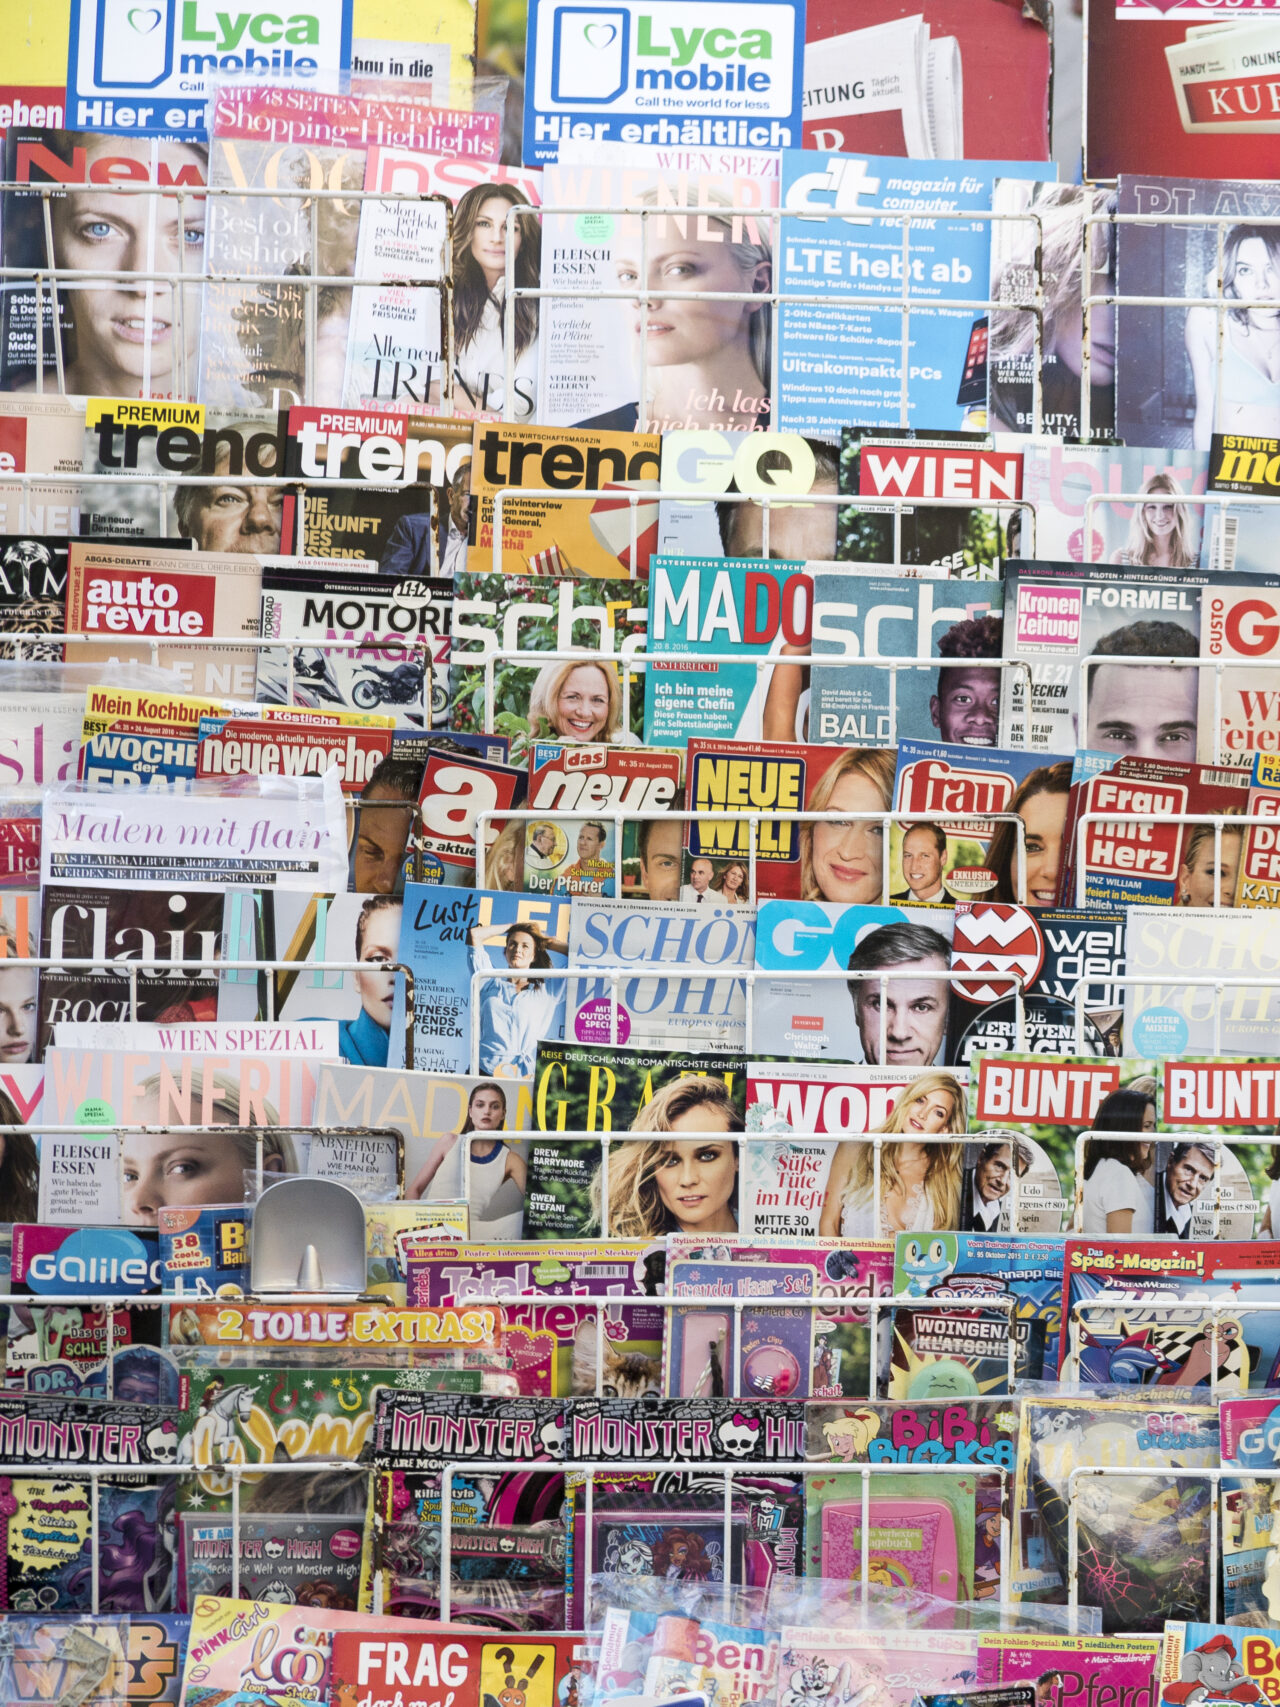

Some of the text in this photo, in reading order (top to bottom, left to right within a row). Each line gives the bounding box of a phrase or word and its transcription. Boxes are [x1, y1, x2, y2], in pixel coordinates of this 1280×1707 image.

[181, 4, 320, 50] Lyca
[637, 16, 772, 65] Lyca
[180, 49, 319, 78] mobile
[1179, 63, 1206, 76] HANDY
[635, 65, 771, 92] mobile
[635, 97, 769, 110] Call the world for less
[216, 101, 494, 156] Shopping-Highlights
[535, 116, 791, 148] Hier erhältlich
[887, 177, 983, 195] magazin für
[786, 249, 972, 284] LTE hebt ab
[117, 406, 200, 424] PREMIUM
[320, 415, 402, 435] PREMIUM
[519, 432, 601, 445] WIRTSCHAFTSMAGAZIN
[676, 431, 816, 505] GQ
[866, 454, 1017, 497] WIEN
[84, 555, 151, 567] ABGAS-DEBATTE
[89, 577, 177, 607] auto
[1019, 588, 1079, 615] Kronen
[1086, 588, 1192, 611] FORMEL
[86, 606, 204, 635] revue
[1018, 613, 1079, 640] Zeitung
[1210, 598, 1223, 654] GUSTO
[654, 684, 733, 697] Ich bin meine
[91, 692, 132, 715] Mein
[654, 696, 735, 711] eigene Chefin
[225, 729, 346, 747] Die moderne, aktuelle Illustrierte
[1263, 755, 1274, 765] 19
[533, 771, 677, 810] neue
[699, 757, 800, 806] NEUE
[1097, 783, 1175, 814] Frau
[54, 815, 329, 854] Malen mit flair
[54, 854, 78, 865] DAS
[184, 857, 216, 868] MODE
[218, 858, 244, 869] ZUM
[1093, 840, 1167, 872] Herz
[54, 868, 104, 878] WERDEN
[107, 869, 128, 878] SIE
[156, 871, 206, 881] EIGENER
[210, 872, 272, 883] DESIGNER!
[530, 874, 604, 893] Der Pfarrer
[950, 880, 997, 889] INTERVIEW
[953, 871, 992, 881] EXKLUSIV
[415, 897, 476, 931] Lust
[667, 1016, 711, 1028] EUROPAS
[158, 1029, 323, 1051] WIEN SPEZIAL
[541, 1050, 708, 1069] REISE DEUTSCHLANDS ROMANTISCHSTE
[53, 1145, 111, 1160] FLEISCH
[534, 1148, 559, 1157] DREW
[53, 1160, 96, 1176] ESSEN
[534, 1157, 584, 1168] BARRYMORE
[777, 1154, 821, 1173] Süße
[776, 1171, 816, 1189] Tüte
[530, 1201, 565, 1213] STEFANI
[531, 1193, 556, 1203] GWEN
[756, 1191, 828, 1209] im Heft!
[673, 1237, 738, 1246] Stylische Mähnen
[174, 1250, 200, 1258] coole
[1087, 1248, 1104, 1257] Das
[166, 1258, 211, 1271] Sticker!
[1071, 1251, 1204, 1275] Spaß-Magazin!
[218, 1311, 494, 1342] 2 TOLLE EXTRAS!
[575, 1416, 712, 1457] MONSTER
[984, 1638, 1155, 1652] Dein Fohlen-Spezial: Mit 5 niedlichen Postern
[359, 1642, 468, 1685] FRAG
